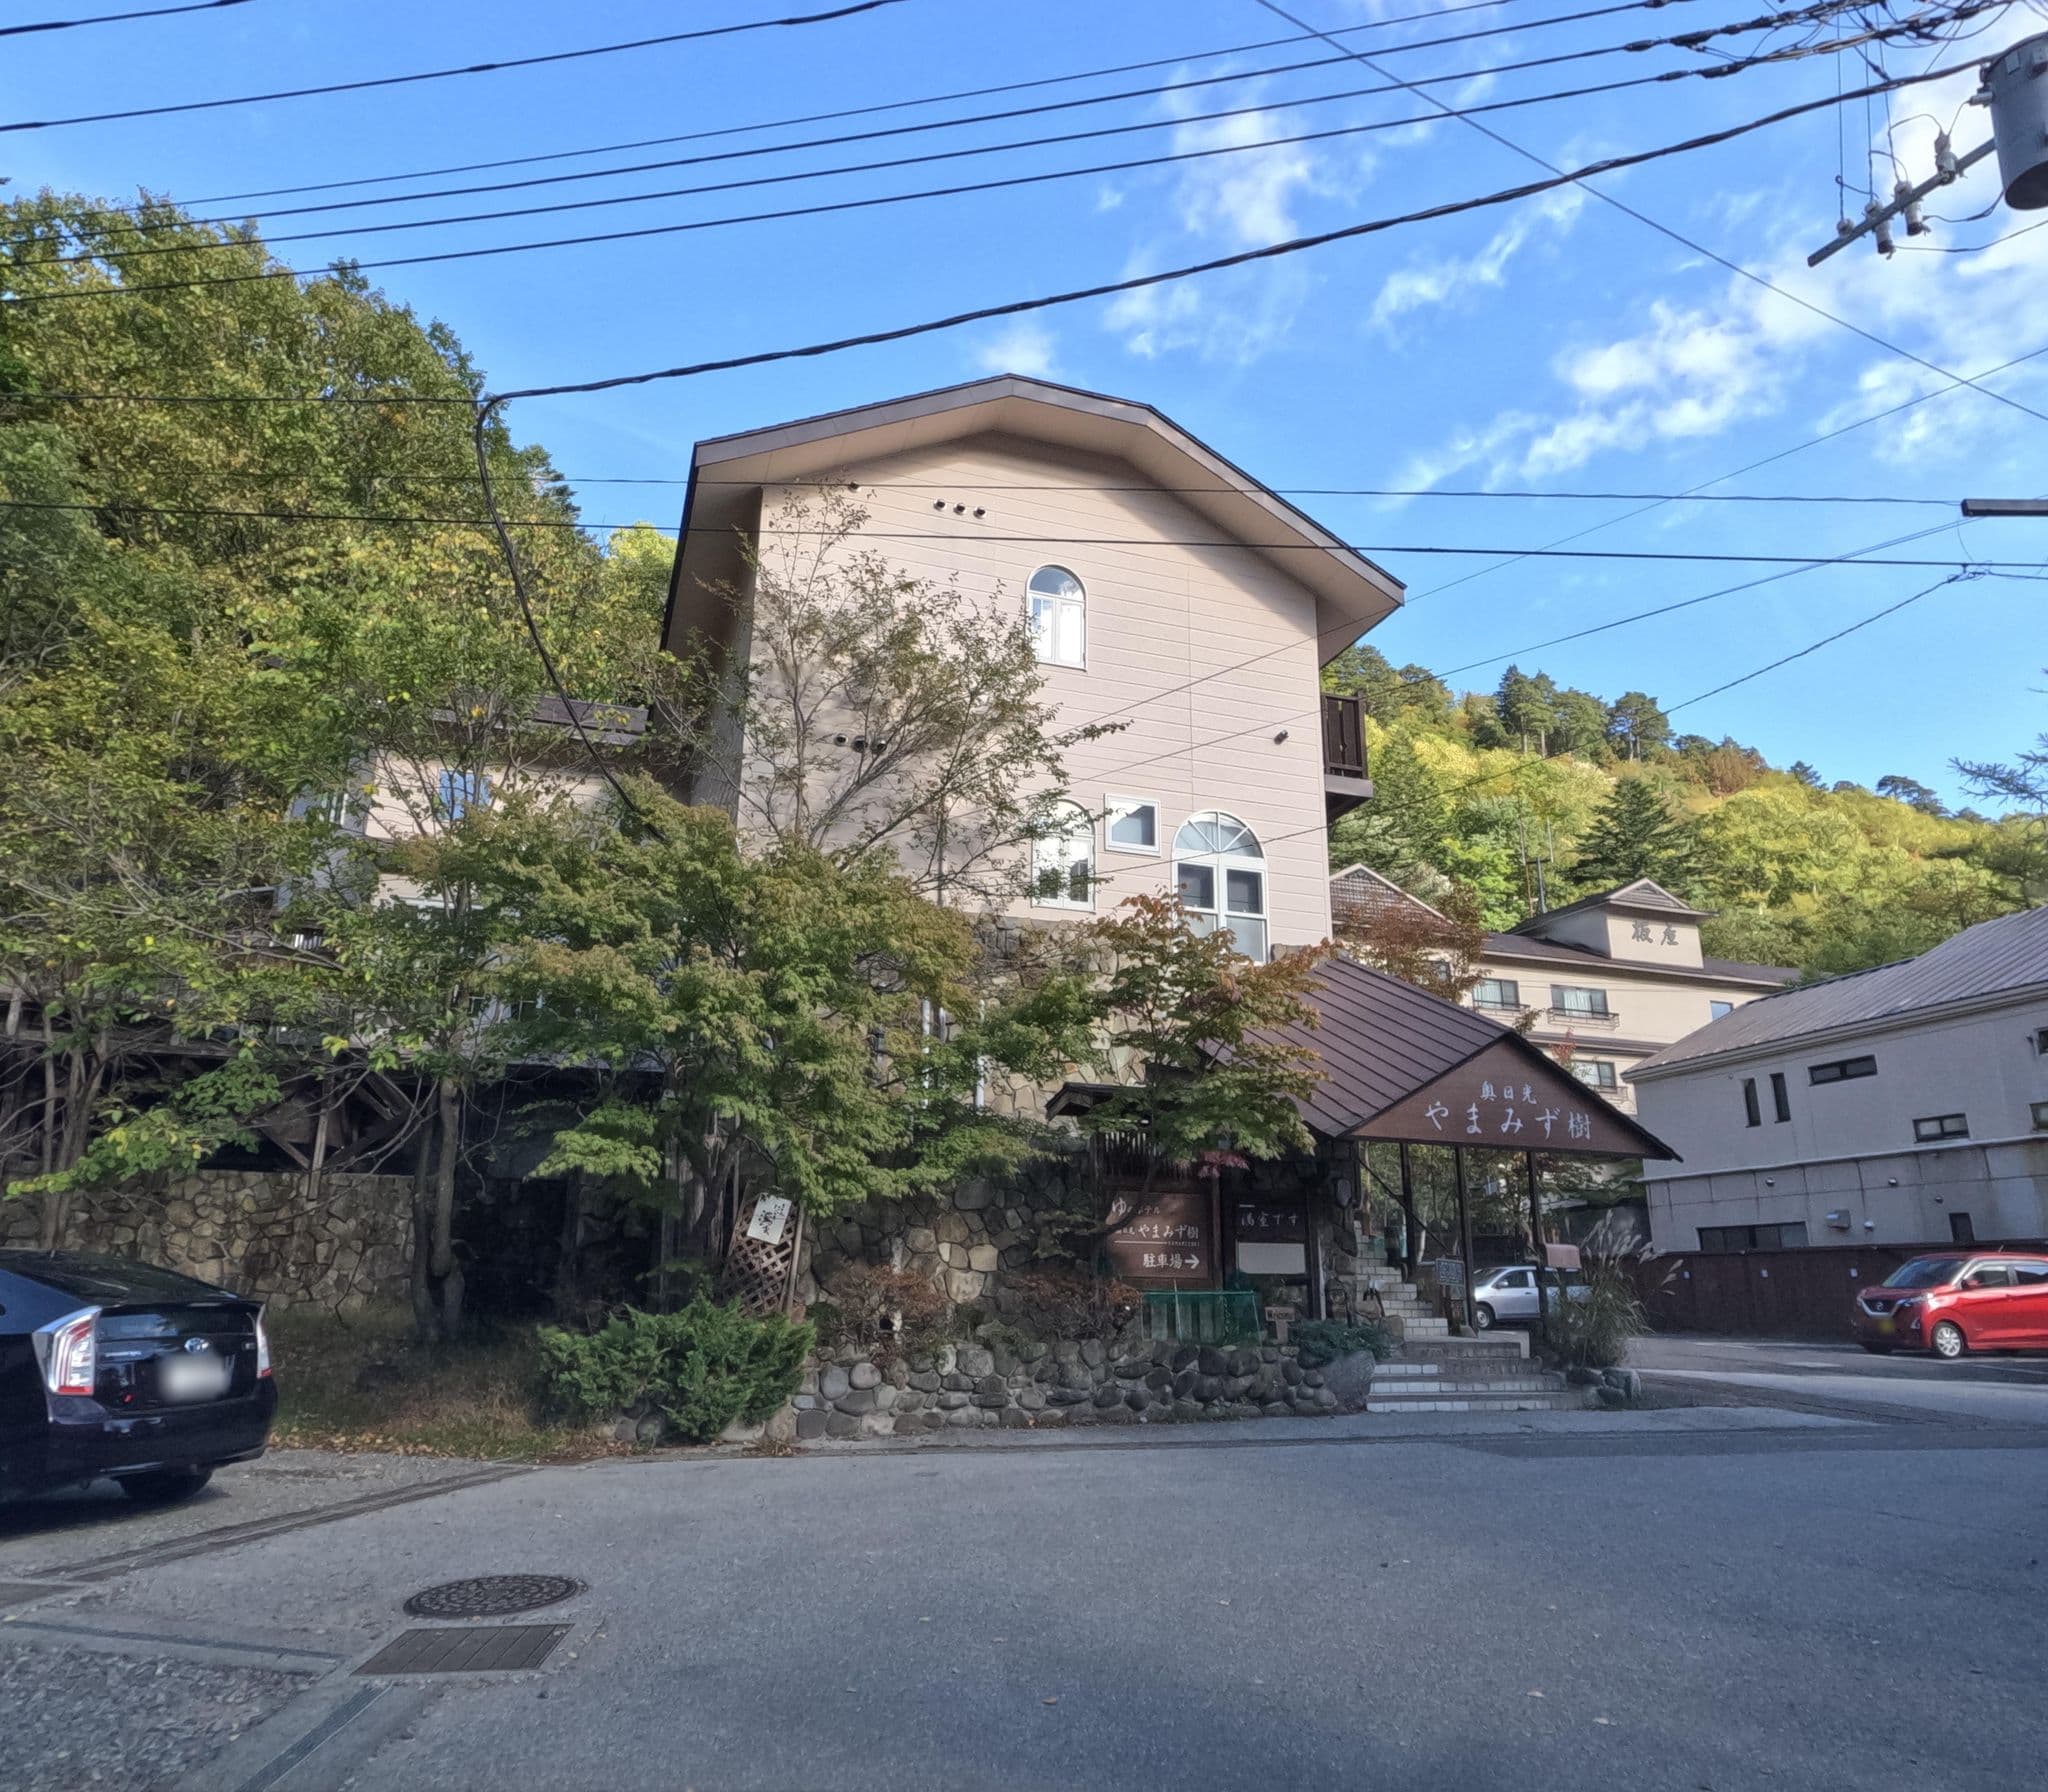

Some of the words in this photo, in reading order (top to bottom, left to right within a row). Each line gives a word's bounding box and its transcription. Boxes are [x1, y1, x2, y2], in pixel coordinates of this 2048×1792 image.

[1480, 1080, 1537, 1105] 奥日光
[1425, 1101, 1592, 1140] やまみず樹
[1138, 1224, 1199, 1240] やまみず樹
[1143, 1253, 1183, 1269] 駐車場
